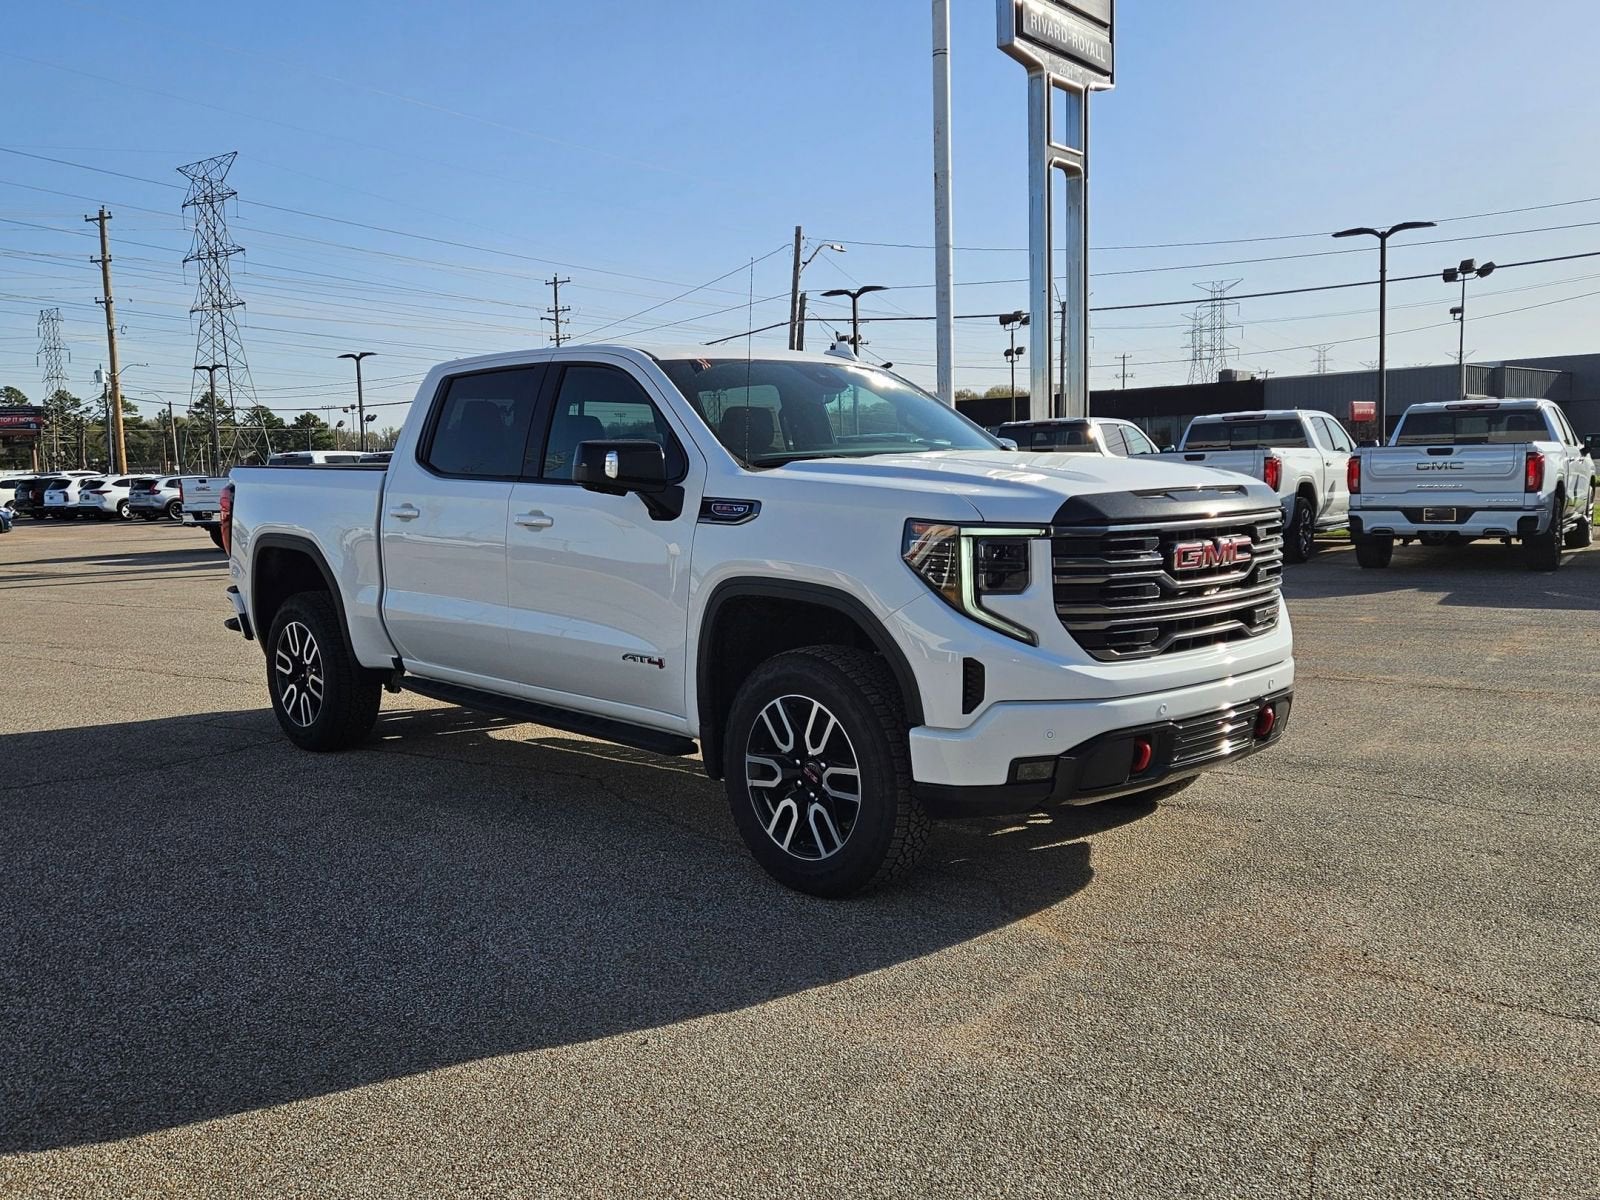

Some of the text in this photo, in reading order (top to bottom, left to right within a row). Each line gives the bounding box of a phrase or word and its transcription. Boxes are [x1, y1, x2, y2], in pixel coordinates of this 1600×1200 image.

[1031, 13, 1106, 63] RIVARD-ROYALL
[1416, 461, 1464, 470] GMC
[1174, 534, 1251, 570] GMC
[622, 653, 666, 669] AT4
